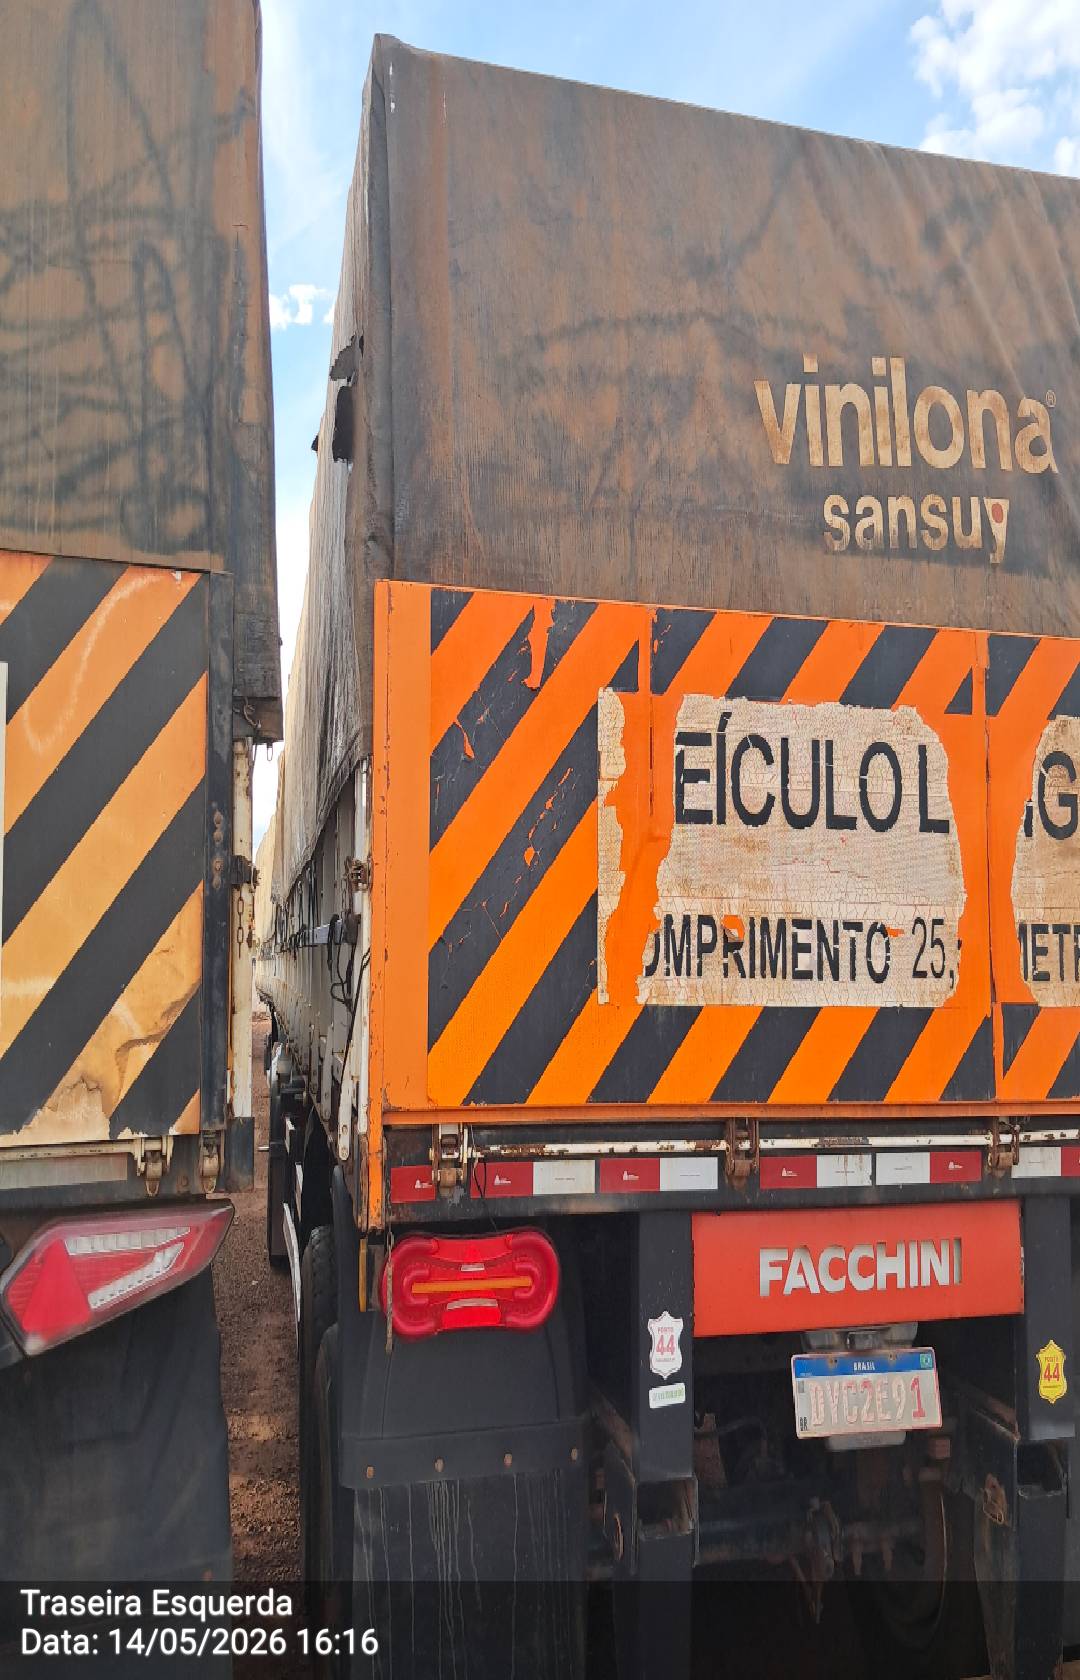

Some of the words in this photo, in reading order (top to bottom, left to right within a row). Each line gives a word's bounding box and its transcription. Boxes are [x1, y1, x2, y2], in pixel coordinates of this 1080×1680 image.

[754, 353, 1059, 474] vinilona
[823, 495, 1010, 564] sansuy
[911, 916, 962, 989] 25,
[759, 1237, 963, 1297] FACCHINI
[656, 1334, 675, 1355] 44
[853, 1361, 876, 1372] BRASIL
[1043, 1362, 1060, 1382] 44
